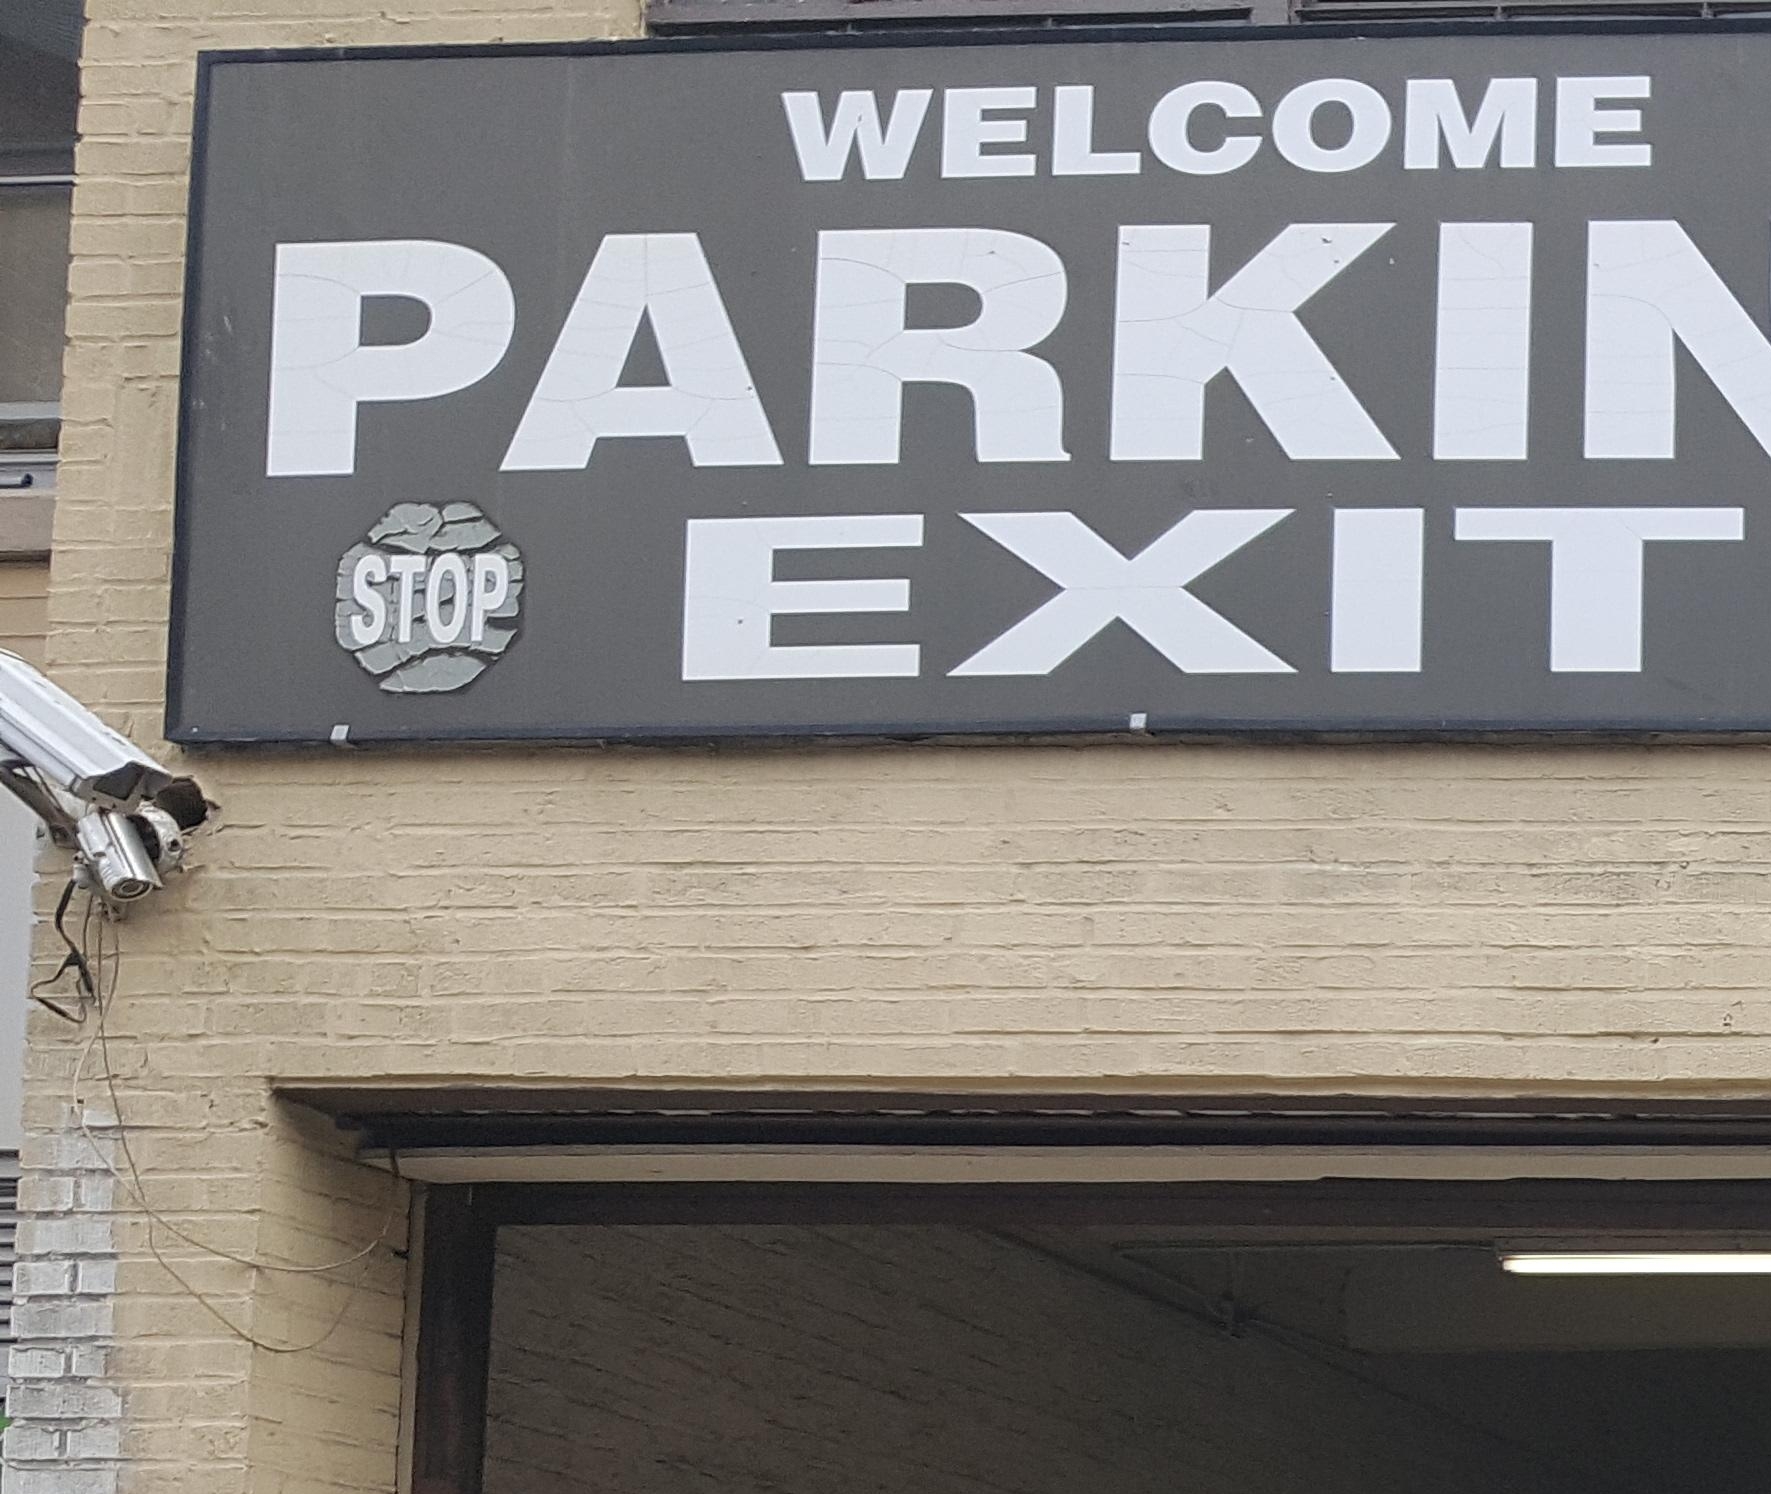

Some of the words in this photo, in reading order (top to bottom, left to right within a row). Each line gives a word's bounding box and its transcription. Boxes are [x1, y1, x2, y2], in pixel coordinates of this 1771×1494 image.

[781, 76, 1652, 181] WELCOME
[347, 549, 509, 651] STOP
[682, 508, 1745, 681] EXIT
